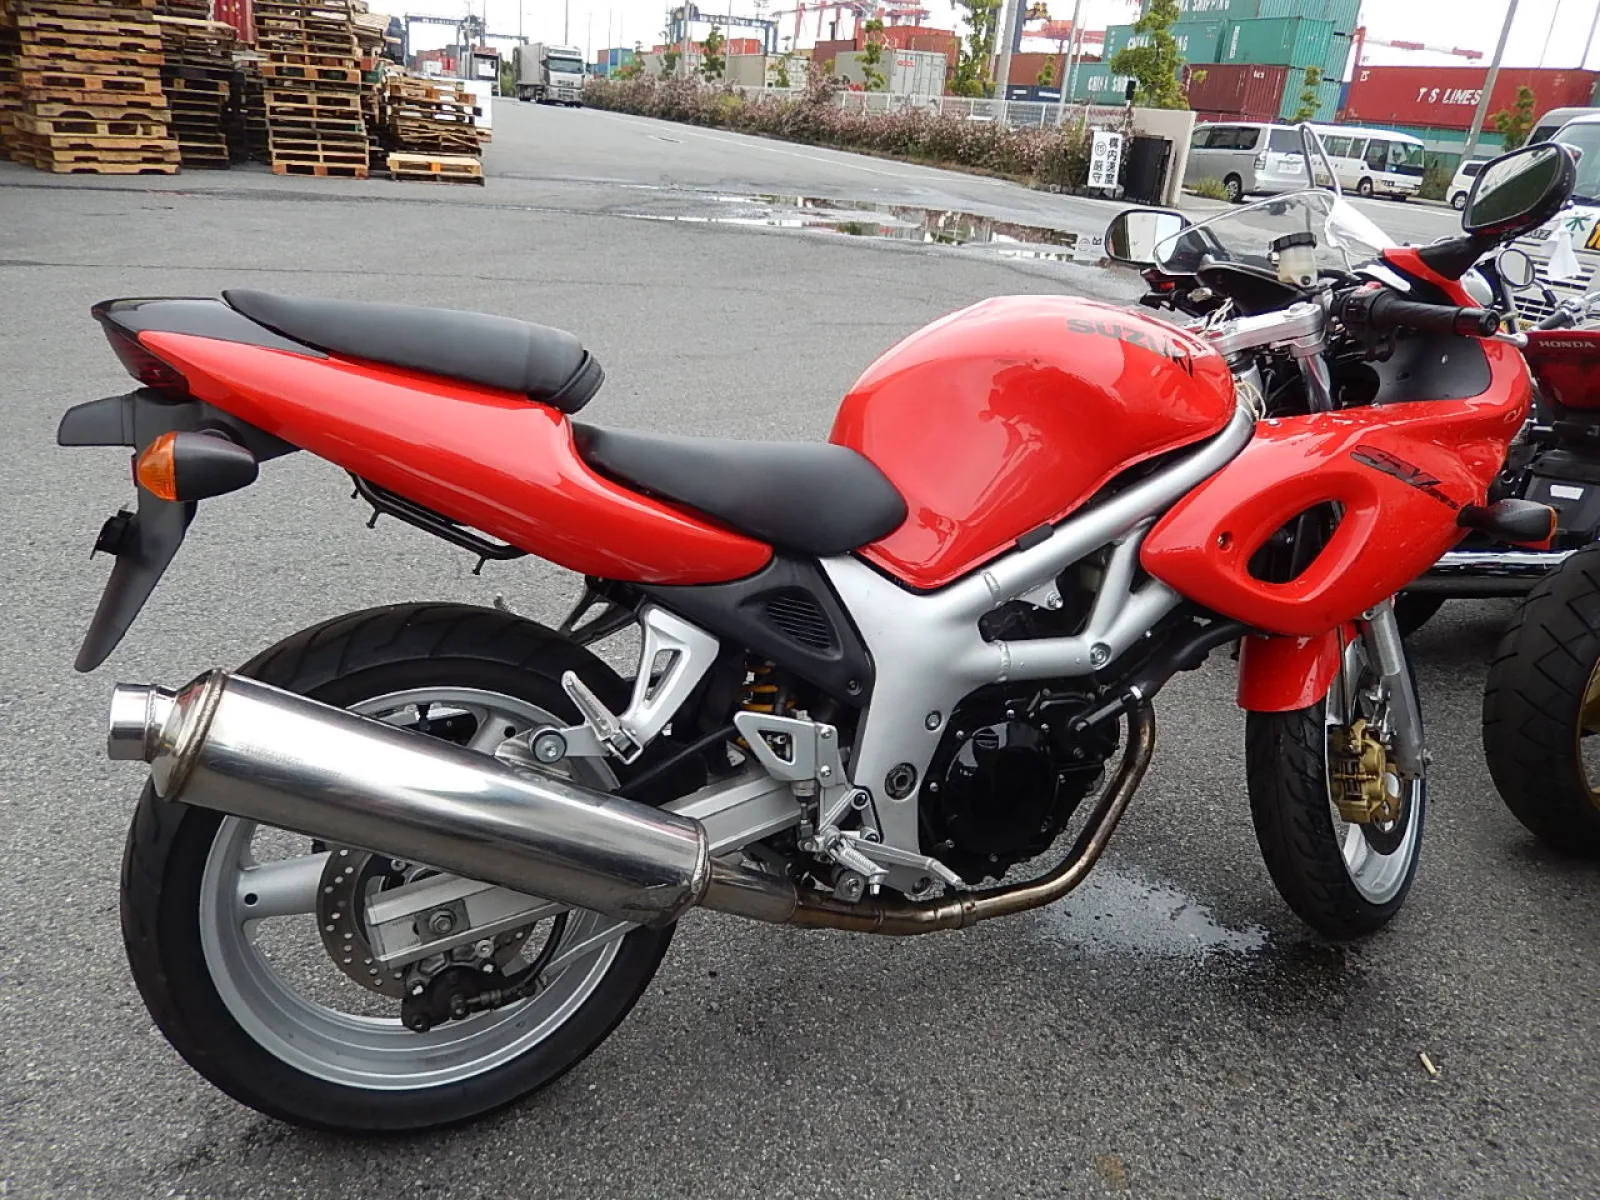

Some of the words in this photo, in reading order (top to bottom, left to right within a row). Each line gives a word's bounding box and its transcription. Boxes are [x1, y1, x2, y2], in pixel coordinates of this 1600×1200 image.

[1417, 87, 1425, 103] T
[1429, 88, 1440, 101] S
[1442, 88, 1481, 105] LINES
[1537, 340, 1597, 349] HONDA
